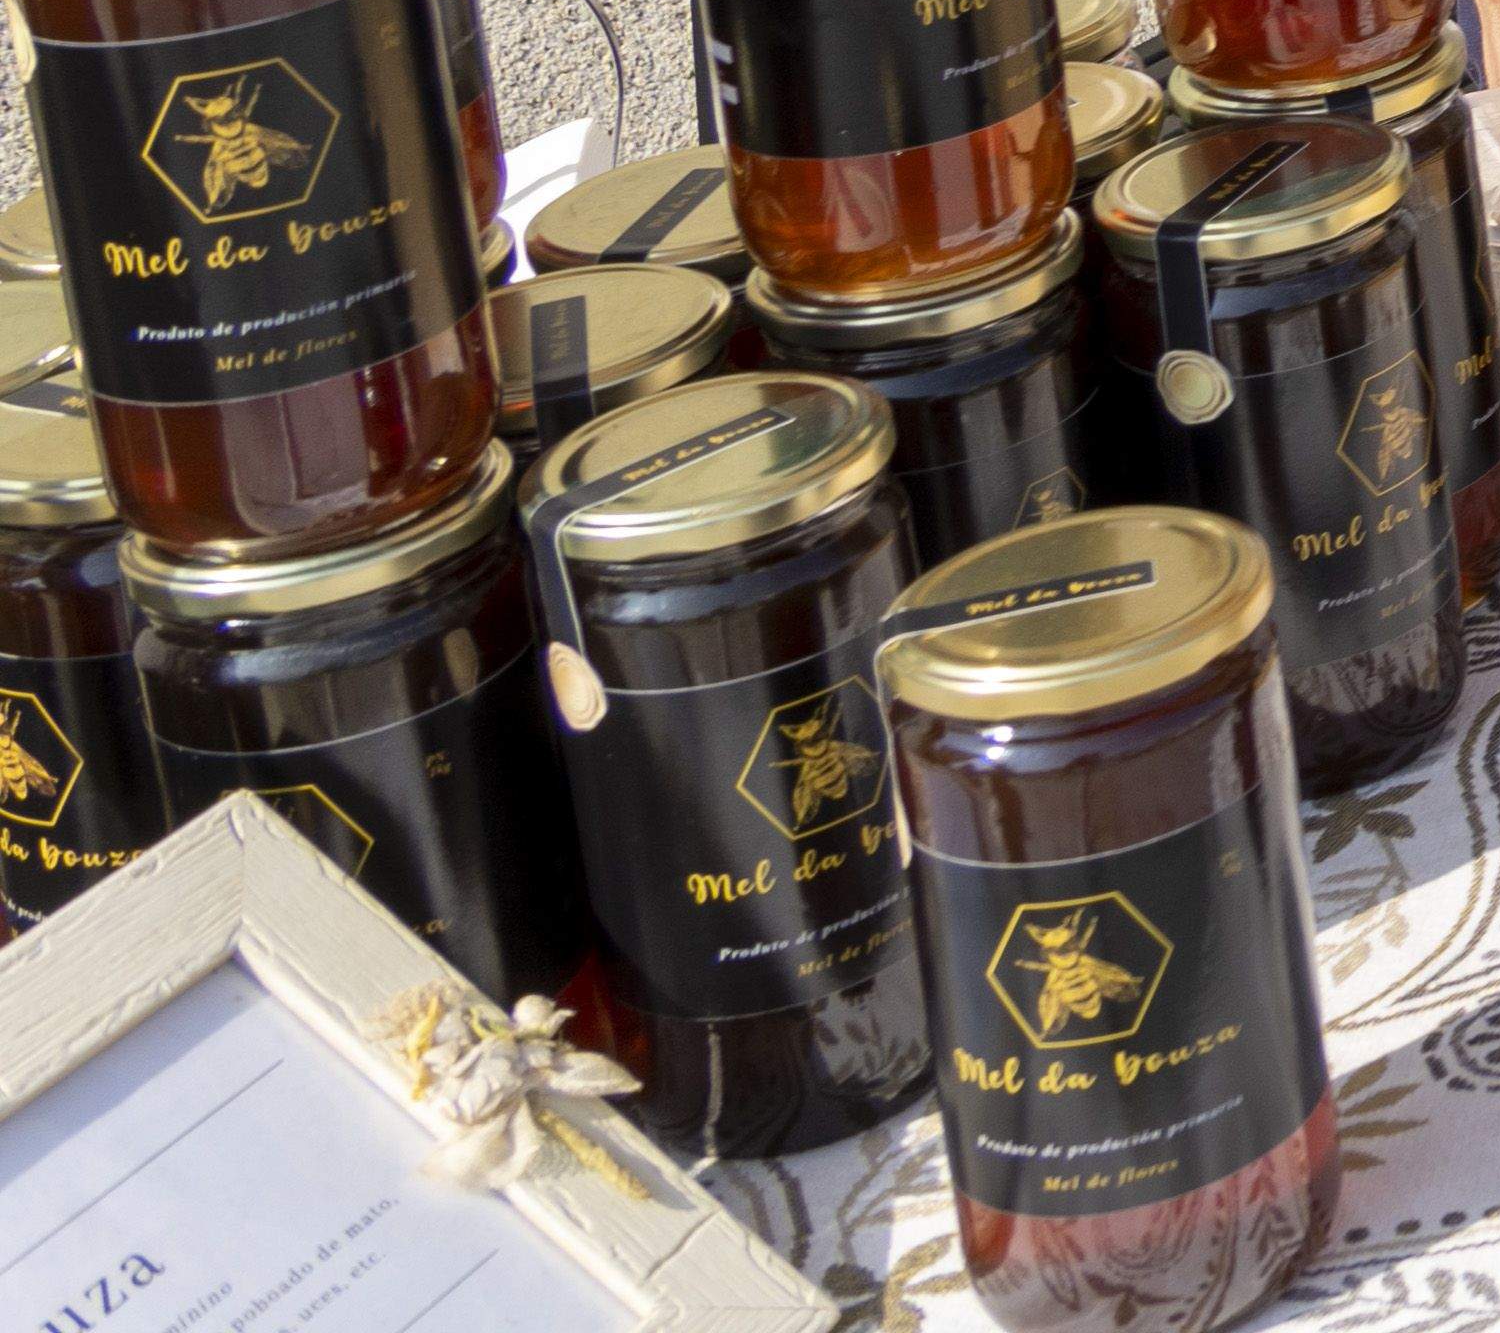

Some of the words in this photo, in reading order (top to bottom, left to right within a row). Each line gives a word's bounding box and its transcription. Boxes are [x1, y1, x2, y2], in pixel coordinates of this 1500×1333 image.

[105, 237, 190, 279] Mel
[207, 235, 269, 269] da
[138, 326, 205, 342] Produto
[212, 322, 234, 338] de
[242, 300, 339, 337] produción
[215, 356, 253, 373] Mel
[263, 349, 288, 365] de
[294, 331, 358, 361] flores
[1293, 515, 1367, 562] Mel
[1377, 504, 1412, 535] da
[686, 858, 778, 905] Mel
[793, 848, 848, 882] da
[719, 938, 790, 963] Produto
[795, 930, 818, 946] de
[797, 953, 835, 978] Mel
[953, 1047, 1025, 1095] Mel
[1039, 1060, 1098, 1095] da
[977, 1134, 1038, 1157] Produto
[1040, 1141, 1061, 1158] de
[1044, 1175, 1080, 1193] Mel
[1087, 1171, 1110, 1190] de
[230, 1262, 315, 1333] poboado
[316, 1237, 341, 1264] de
[344, 1196, 401, 1239] mato,
[299, 1281, 351, 1323] uces,
[350, 1250, 387, 1281] etc.
